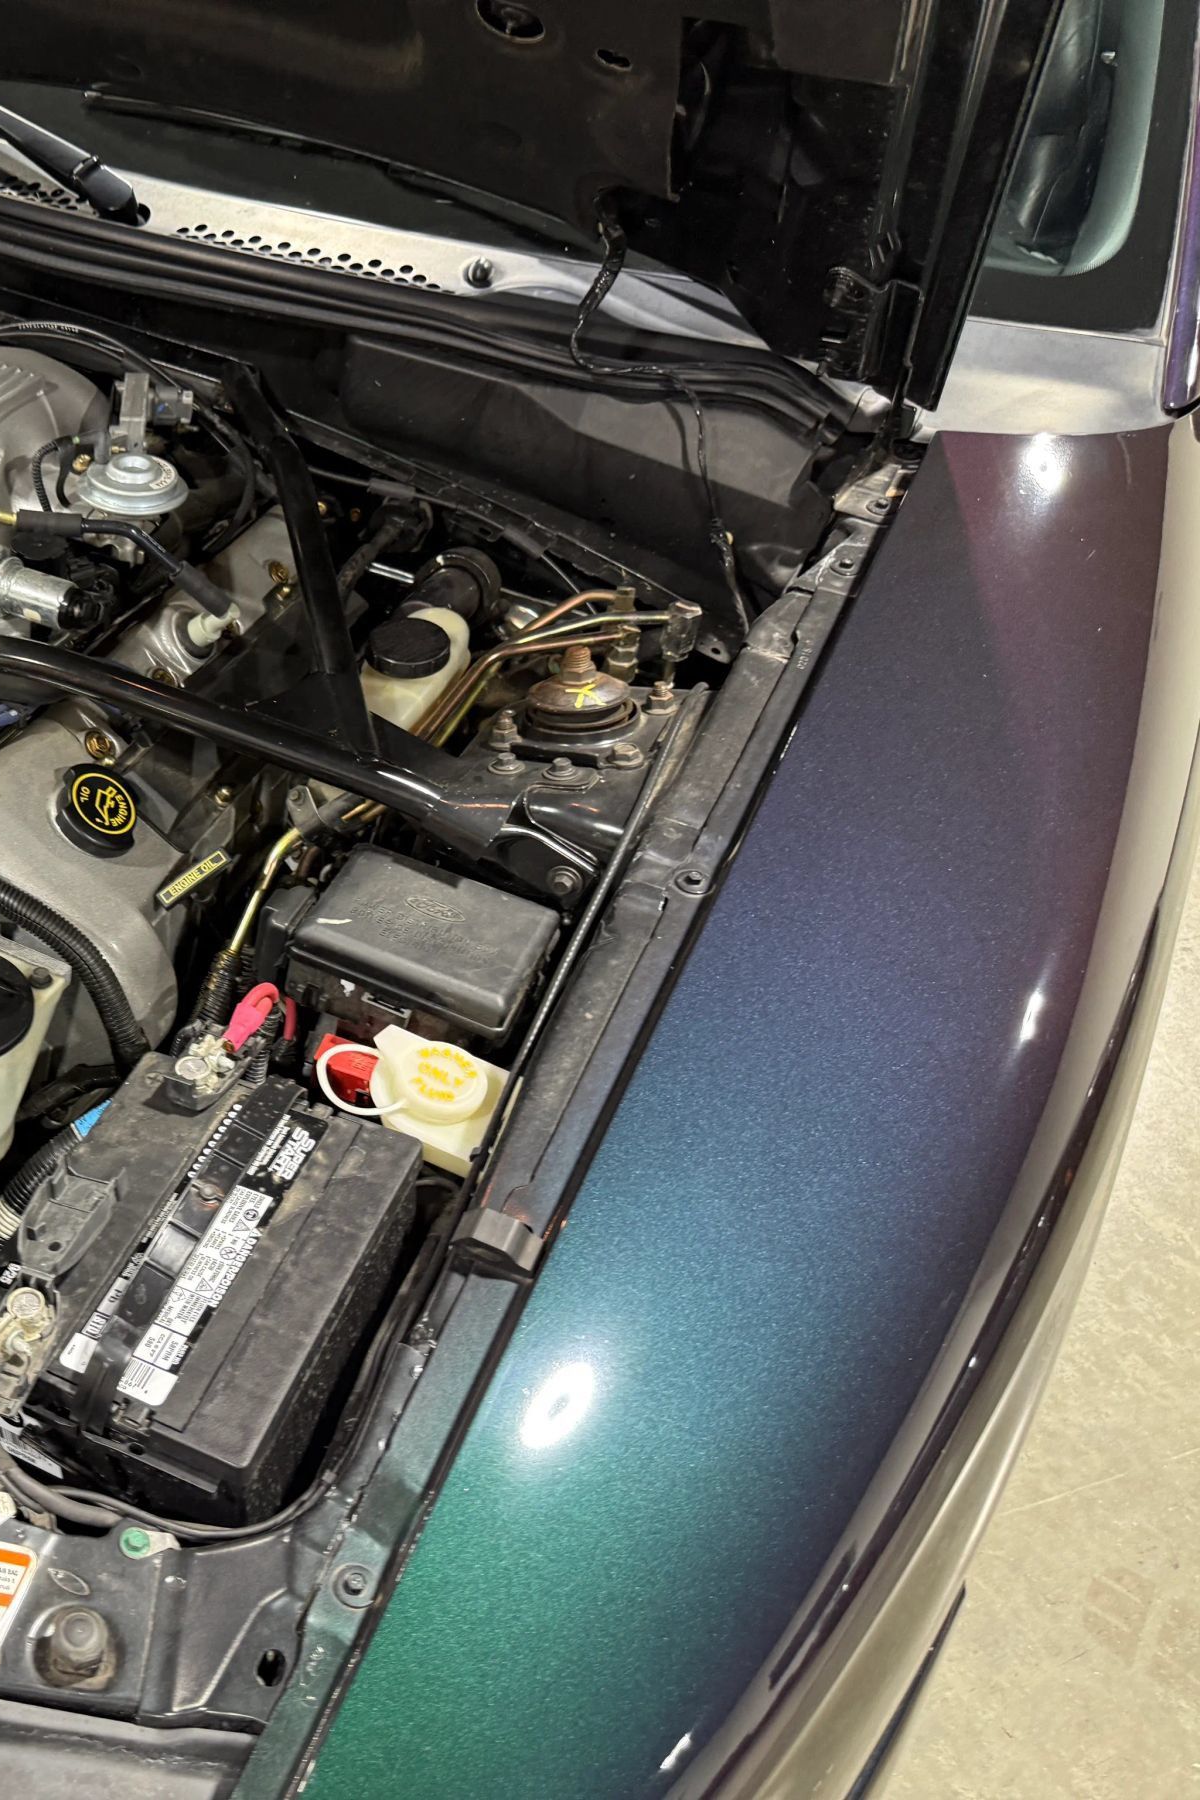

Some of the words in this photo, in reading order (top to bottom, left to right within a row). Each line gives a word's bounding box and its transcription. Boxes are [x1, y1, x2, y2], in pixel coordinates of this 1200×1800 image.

[80, 786, 91, 803] OIL
[111, 796, 128, 828] ENGINE
[169, 870, 200, 897] ENGINE
[201, 860, 218, 873] OIL
[417, 1046, 478, 1078] WASHER
[268, 1126, 311, 1177] START
[278, 1136, 316, 1181] SUPER
[206, 1236, 257, 1308] DANGER/POISON
